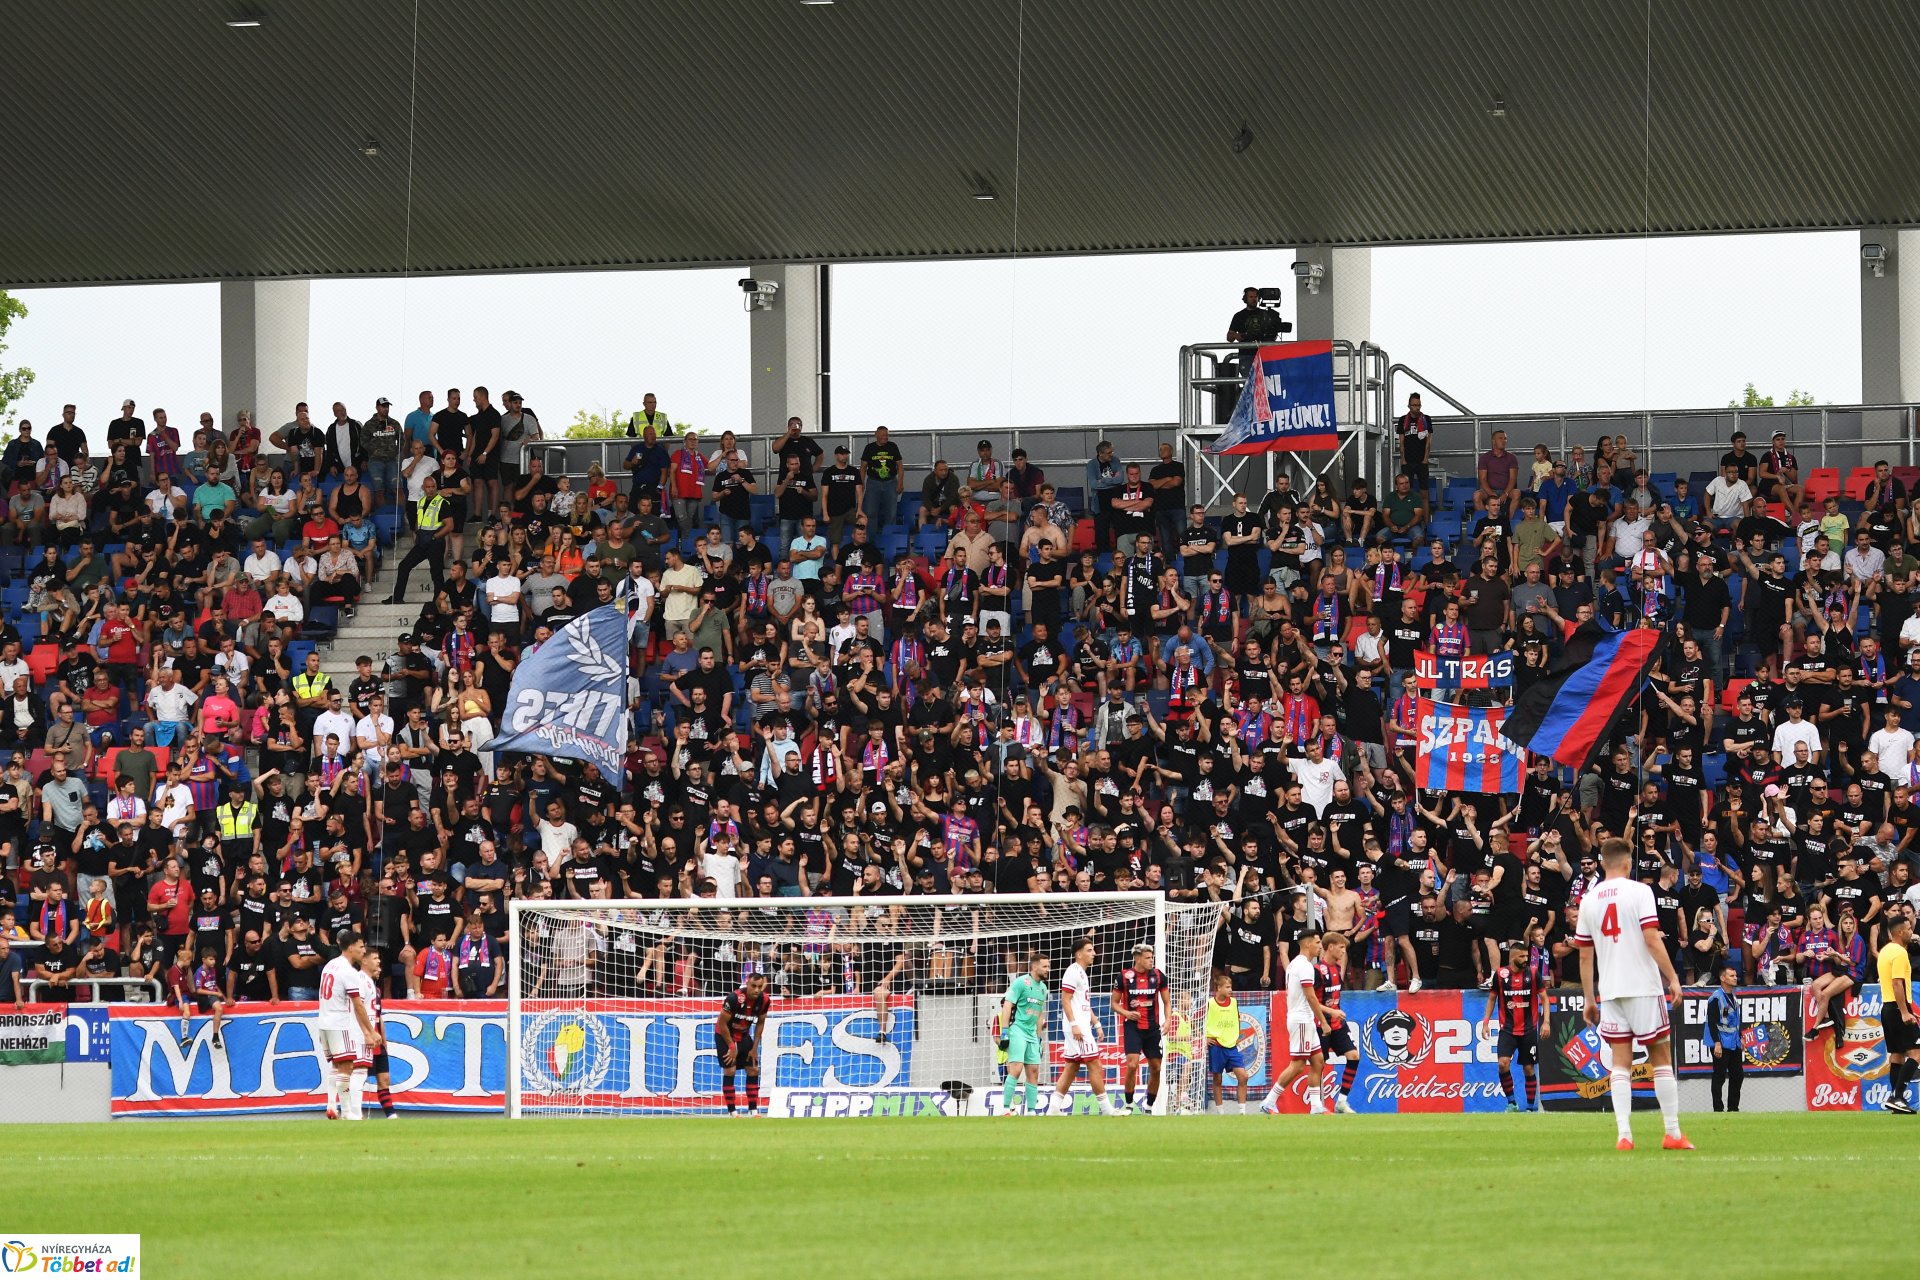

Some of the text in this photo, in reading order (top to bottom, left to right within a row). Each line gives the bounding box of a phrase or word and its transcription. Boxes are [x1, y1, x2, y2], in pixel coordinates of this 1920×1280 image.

[1269, 402, 1332, 434] VELÜNK!
[420, 583, 431, 592] 14
[398, 617, 410, 626] 13
[376, 652, 387, 661] 12
[1601, 903, 1622, 944] 4
[319, 972, 335, 1001] 10
[1560, 995, 1585, 1012] 192
[1844, 1030, 1881, 1041] YVSSC
[1811, 1083, 1858, 1108] Best
